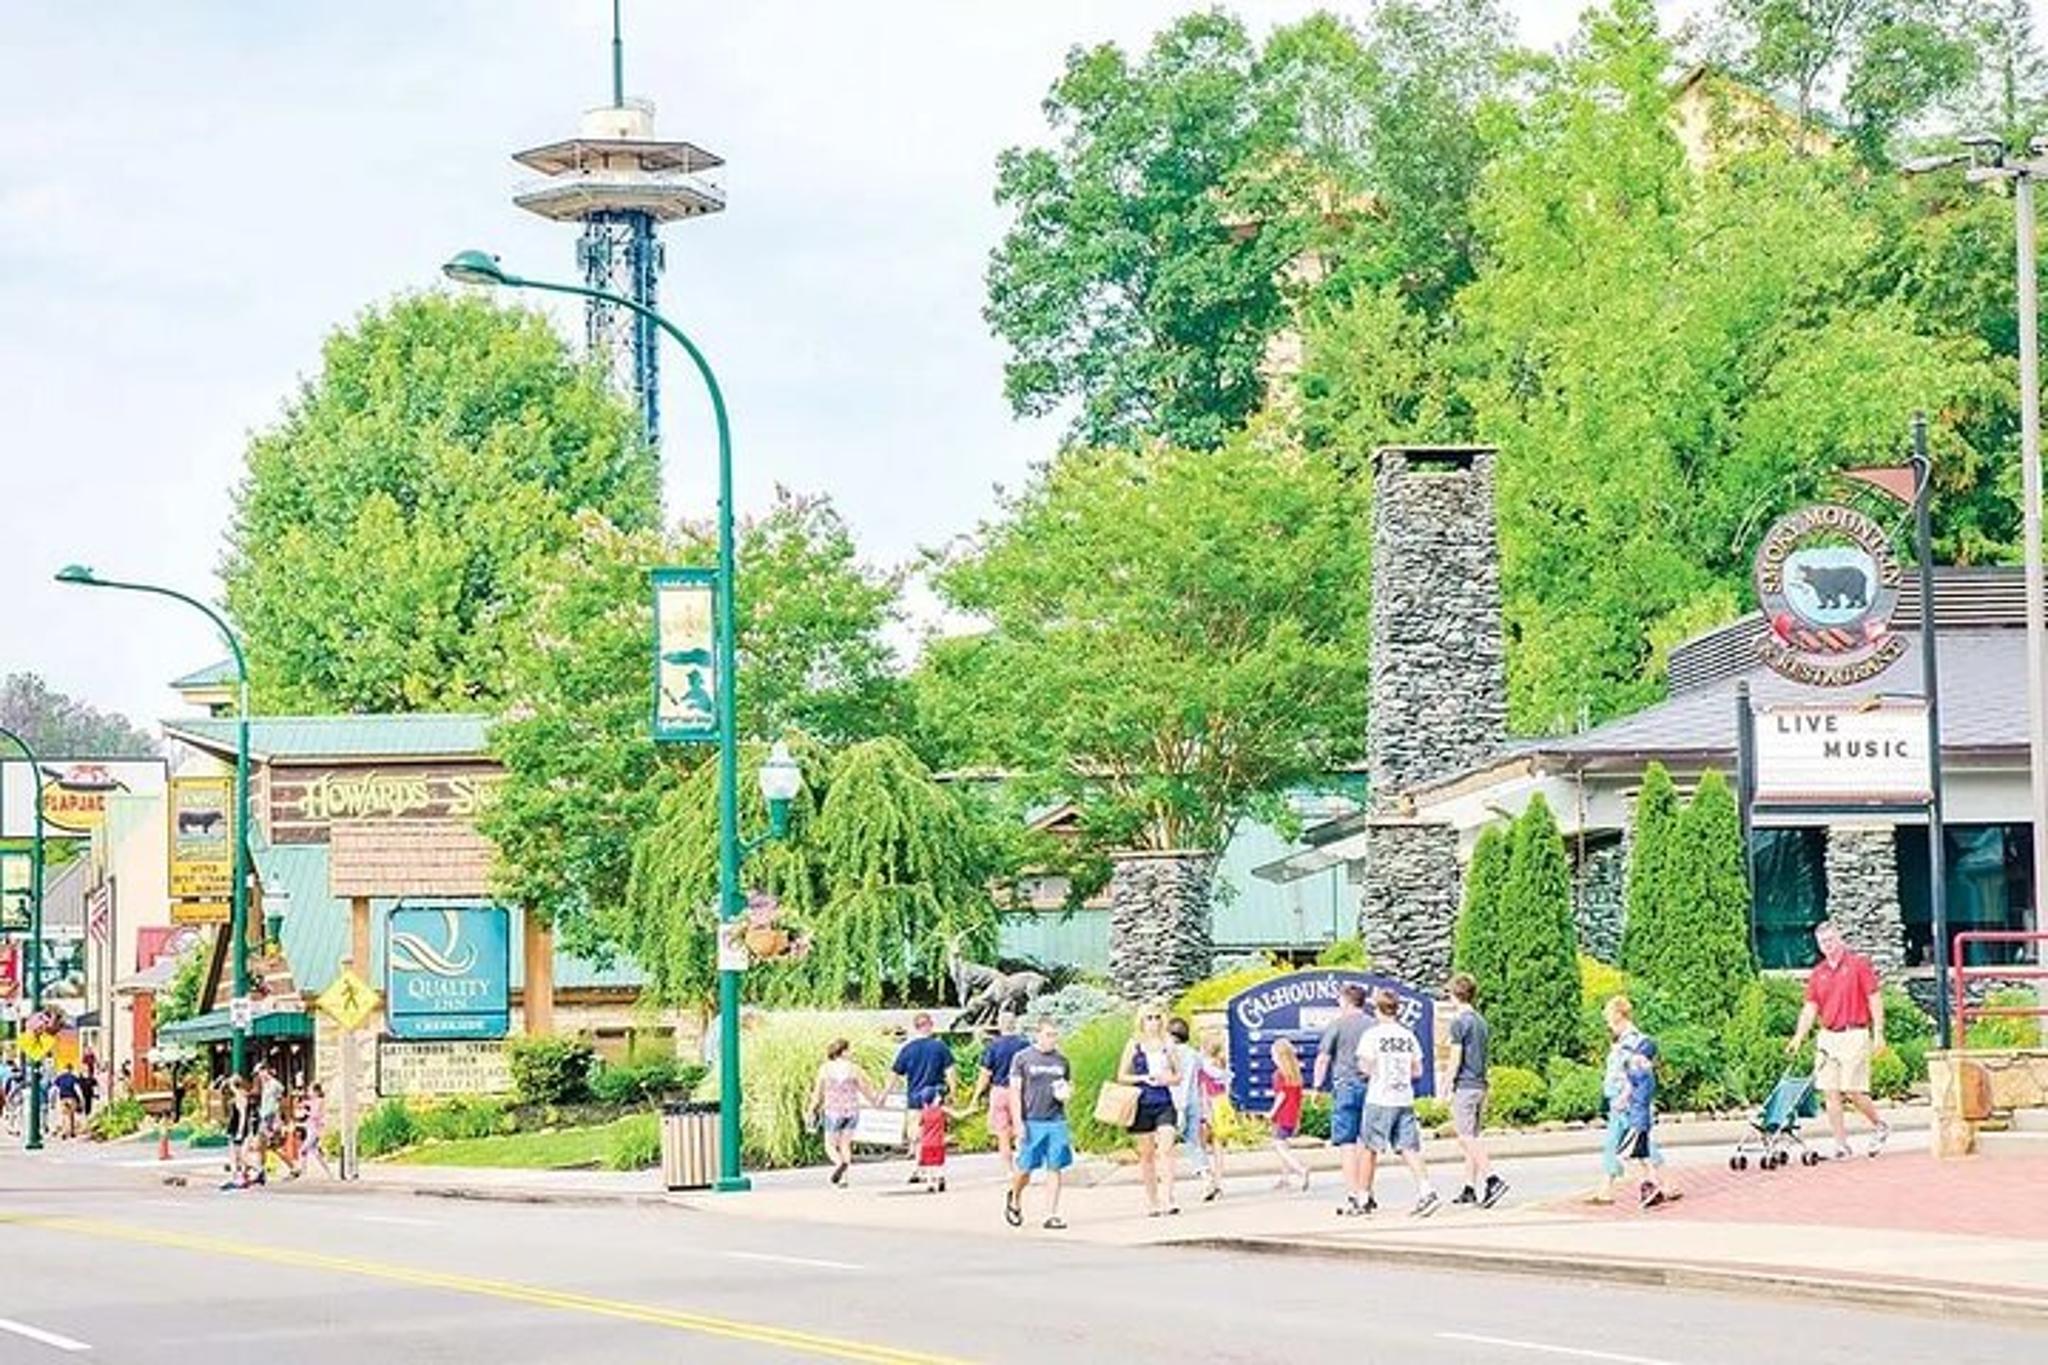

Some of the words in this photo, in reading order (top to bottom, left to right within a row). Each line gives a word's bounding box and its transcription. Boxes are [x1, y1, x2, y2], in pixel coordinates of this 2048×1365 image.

[1762, 521, 1799, 594] SMOKY
[1777, 715, 1838, 733] LIVE
[1823, 740, 1908, 758] MUSIC
[409, 978, 490, 999] QUALITY
[434, 999, 468, 1012] INN
[1237, 973, 1341, 1028] CALHOUN'S
